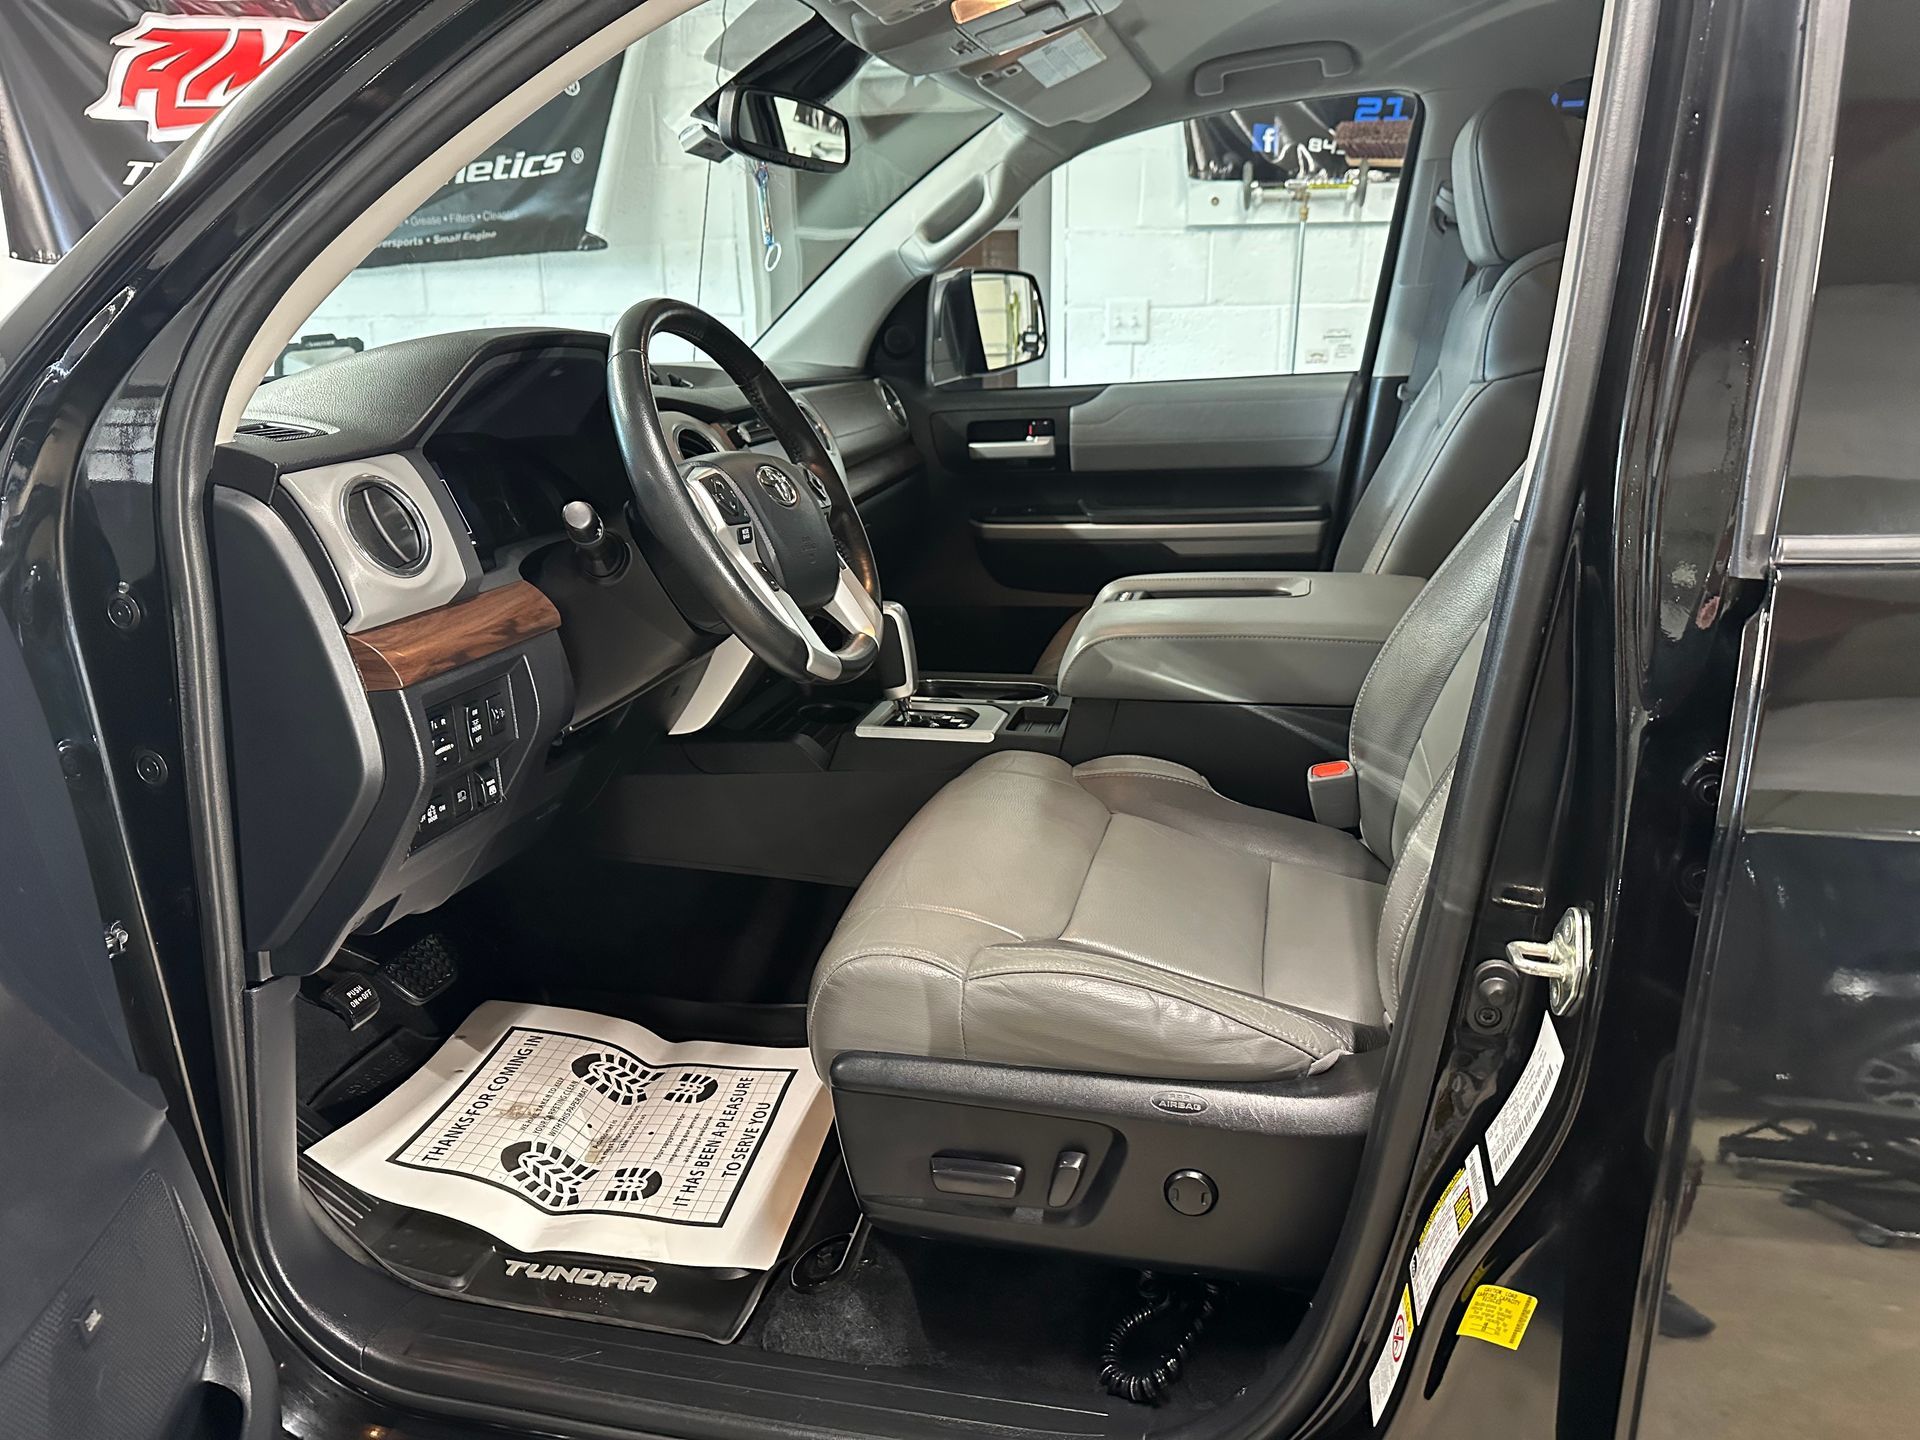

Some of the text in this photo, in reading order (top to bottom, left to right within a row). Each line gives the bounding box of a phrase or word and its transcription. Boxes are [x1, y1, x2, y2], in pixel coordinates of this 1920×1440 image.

[1308, 137, 1346, 155] 84
[449, 213, 476, 224] Filters
[433, 232, 462, 245] Small
[462, 230, 497, 242] Engine
[346, 984, 364, 999] PUSH
[422, 1035, 544, 1161] THANKS FOR COMING IN
[533, 1120, 547, 1134] YOUR
[562, 1080, 579, 1096] CLEAN
[536, 1093, 551, 1113] TAKEN
[555, 1077, 564, 1087] KEEP
[547, 1087, 589, 1137] WITH THIS PAPER MAT
[1158, 1099, 1202, 1112] AIRBAG
[672, 1077, 755, 1207] IT HAS BEEN A PLEASURE
[721, 1102, 771, 1178] TO SERVE YOU
[505, 1259, 658, 1294] TUNDRA
